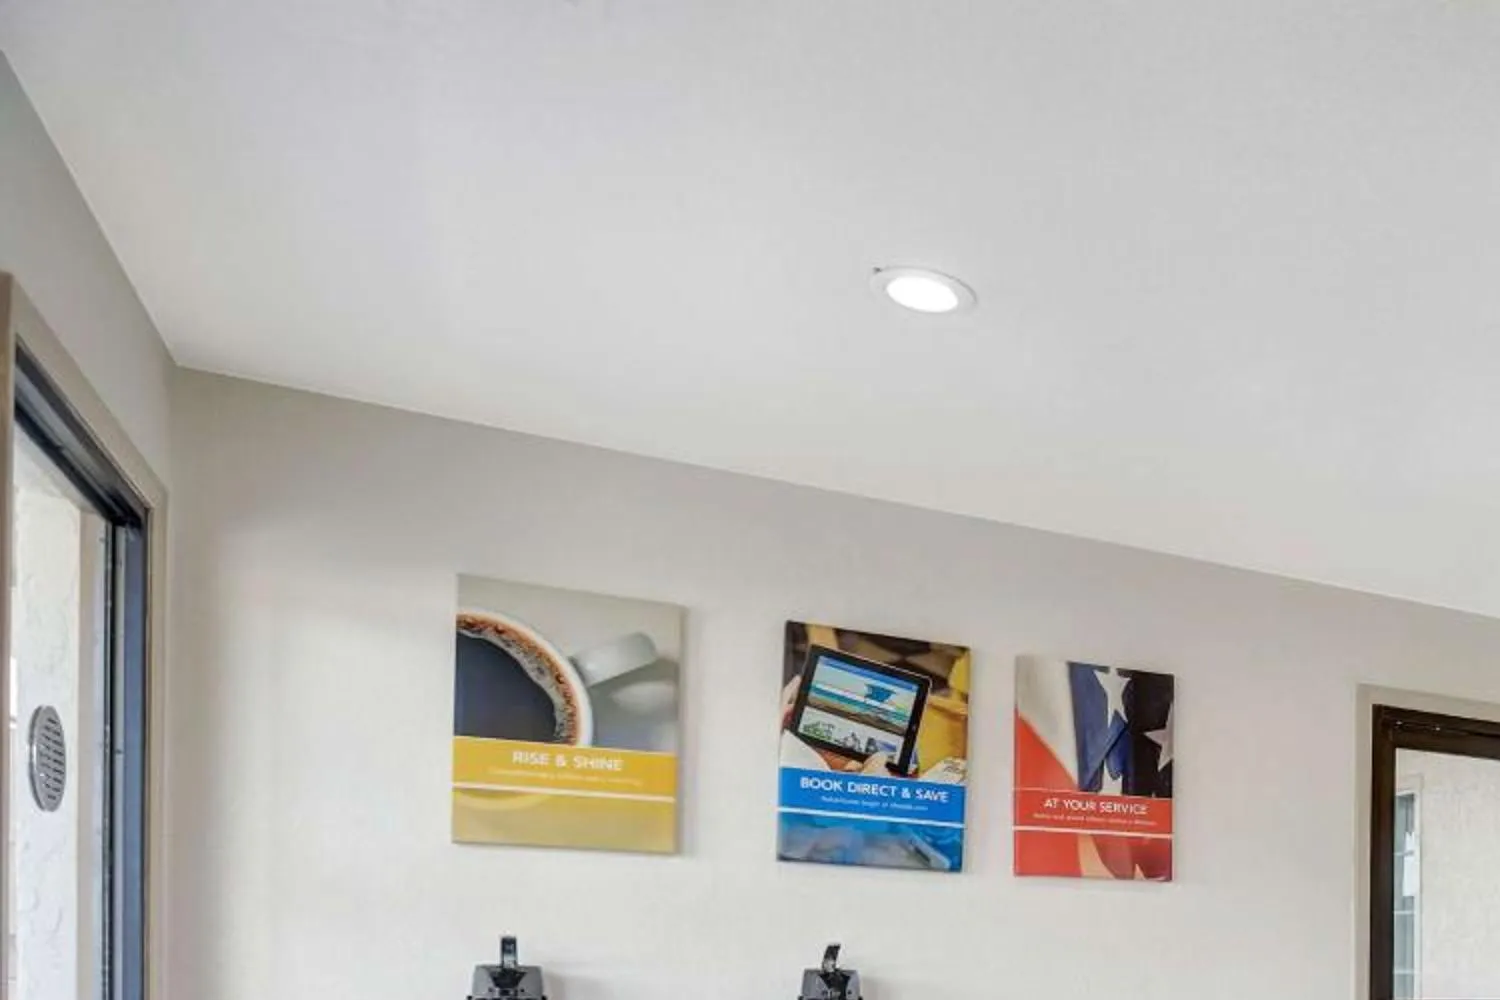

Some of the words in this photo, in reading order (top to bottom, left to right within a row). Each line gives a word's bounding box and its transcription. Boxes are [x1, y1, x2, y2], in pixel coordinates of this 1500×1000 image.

[512, 750, 549, 766] RISE
[555, 754, 566, 768] &
[572, 754, 624, 771] SHINE
[800, 776, 843, 793] BOOK
[847, 781, 897, 798] DIRECT
[901, 787, 911, 799] &
[915, 788, 949, 803] SAVE
[1043, 797, 1057, 809] AT
[1063, 799, 1096, 812] YOUR
[1100, 801, 1148, 815] SERVICE
